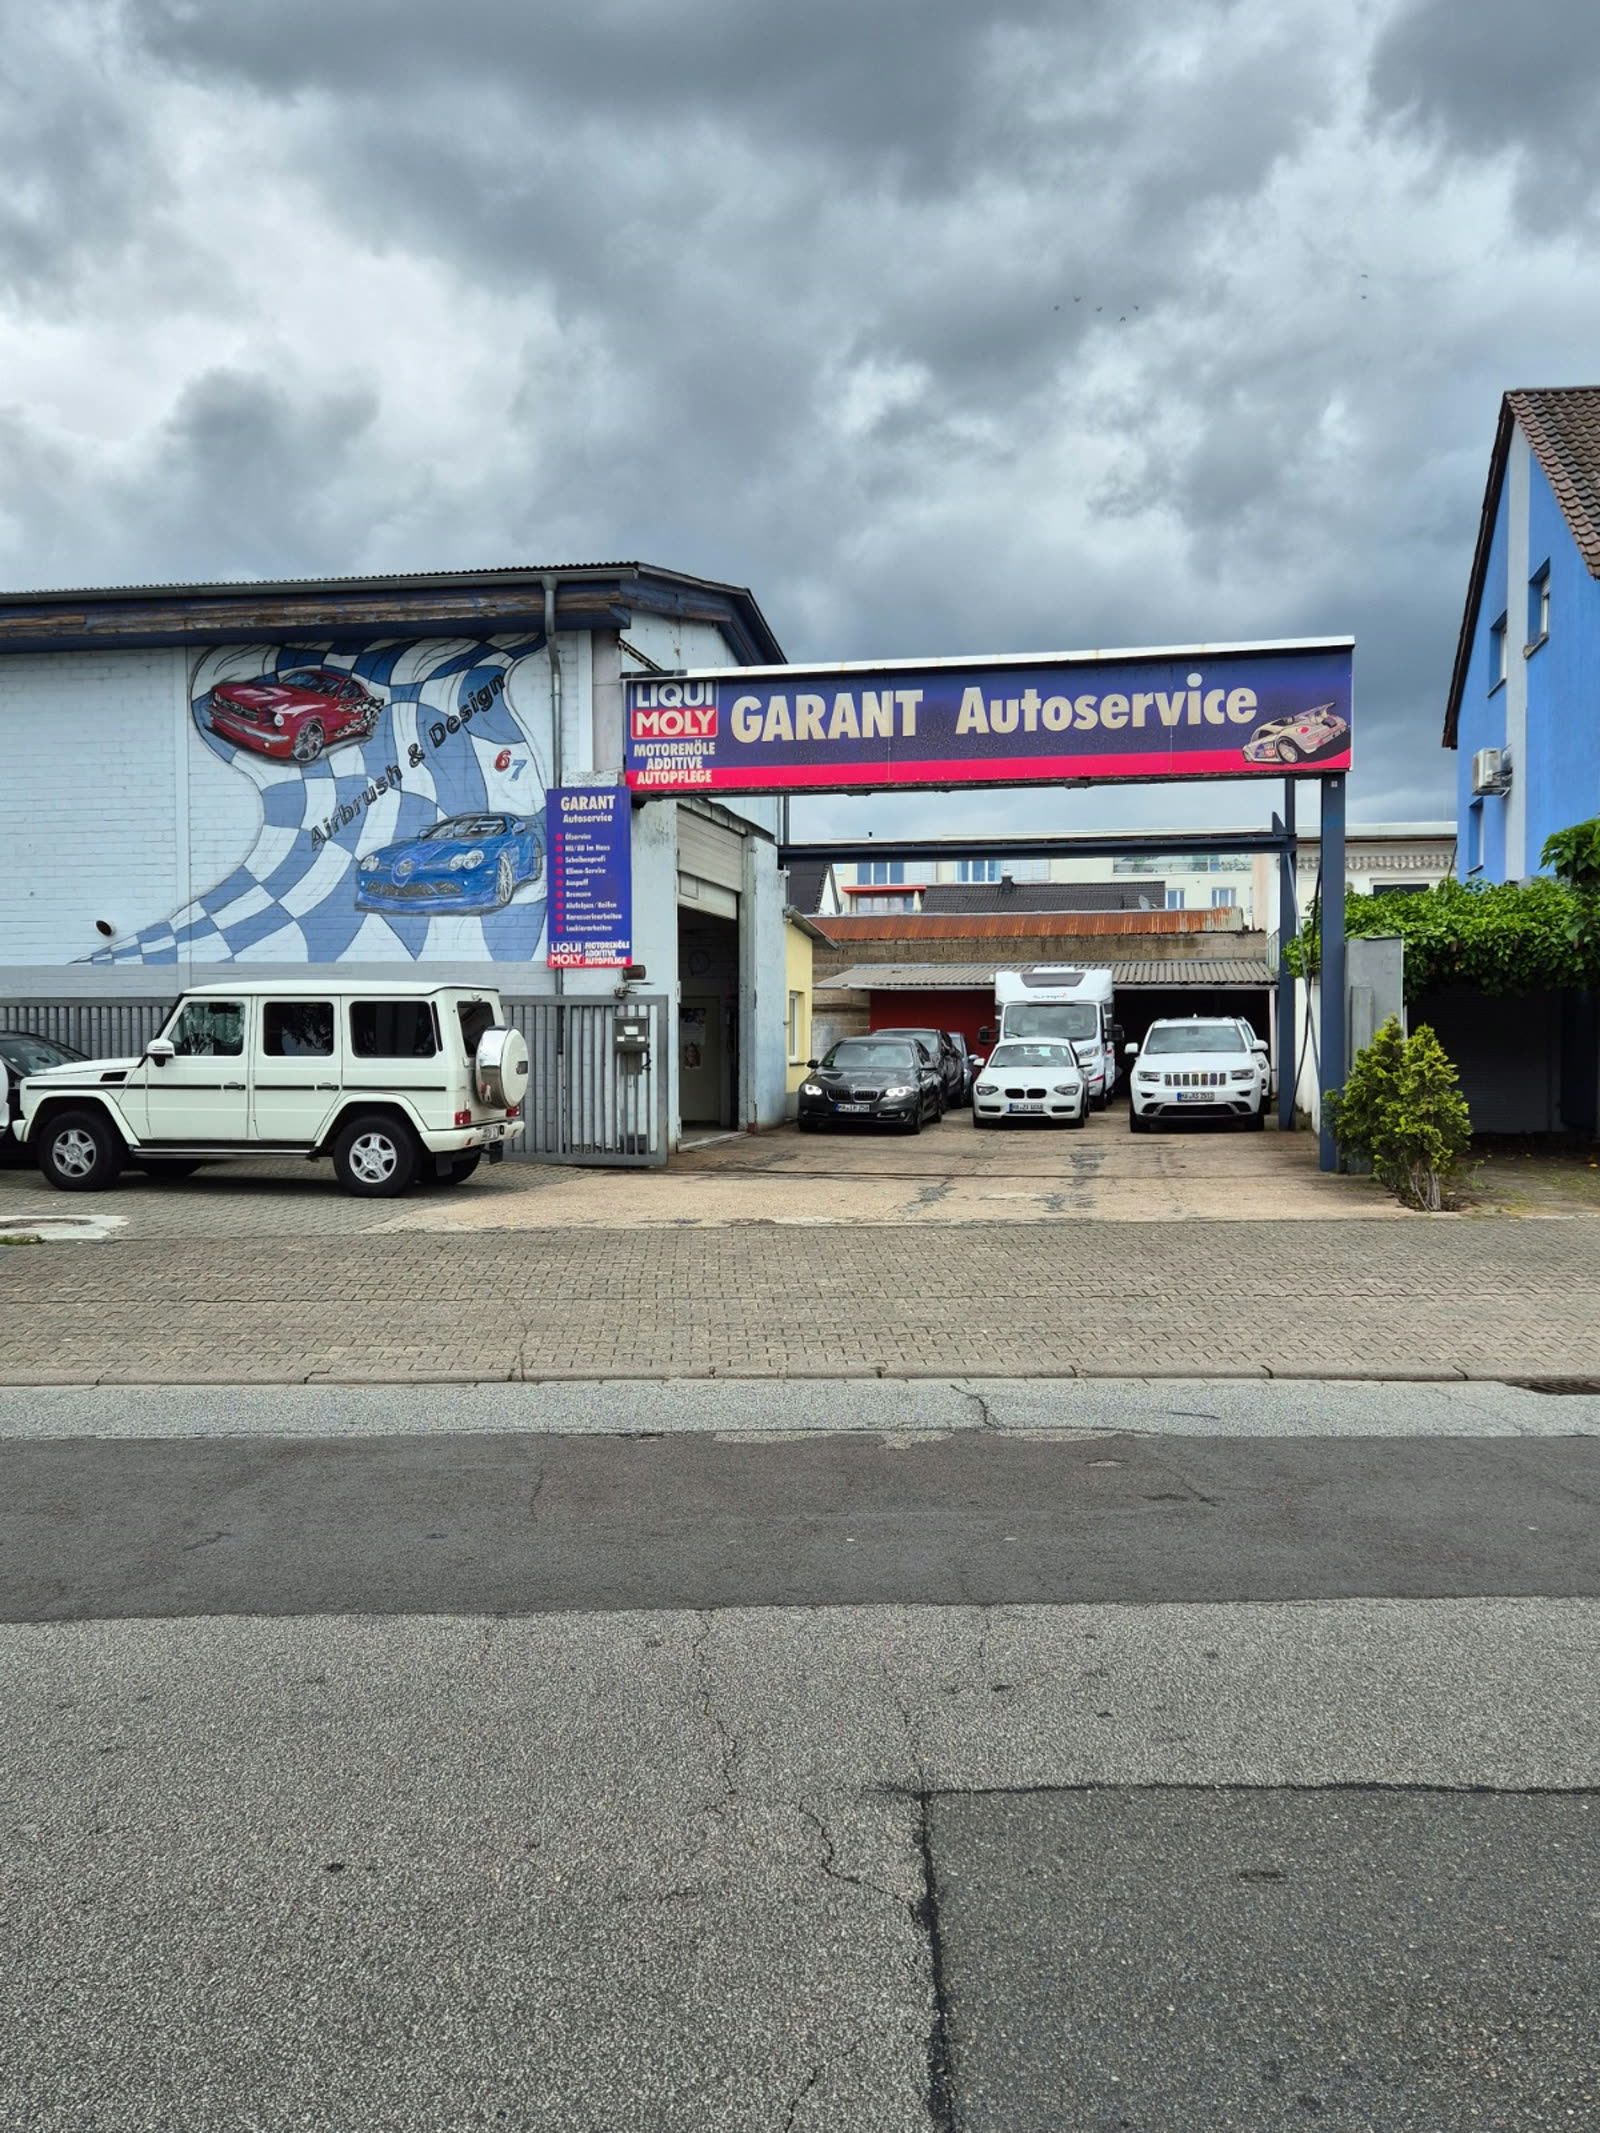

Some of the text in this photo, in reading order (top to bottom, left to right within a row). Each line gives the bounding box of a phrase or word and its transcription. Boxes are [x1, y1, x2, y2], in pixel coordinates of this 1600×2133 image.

[637, 682, 713, 708] LIQUI
[730, 672, 1257, 743] GARANT Autoservice
[636, 710, 715, 736] MOLY
[633, 739, 716, 757] MOTORENÖLE
[311, 673, 505, 851] Airbrush & Design
[646, 756, 703, 771] ADDITIVE
[637, 769, 712, 785] AUTOPFLEGE
[560, 794, 616, 811] GARANT
[563, 811, 613, 823] Autoservice
[551, 942, 582, 954] LIQUI
[551, 954, 583, 965] MOLY
